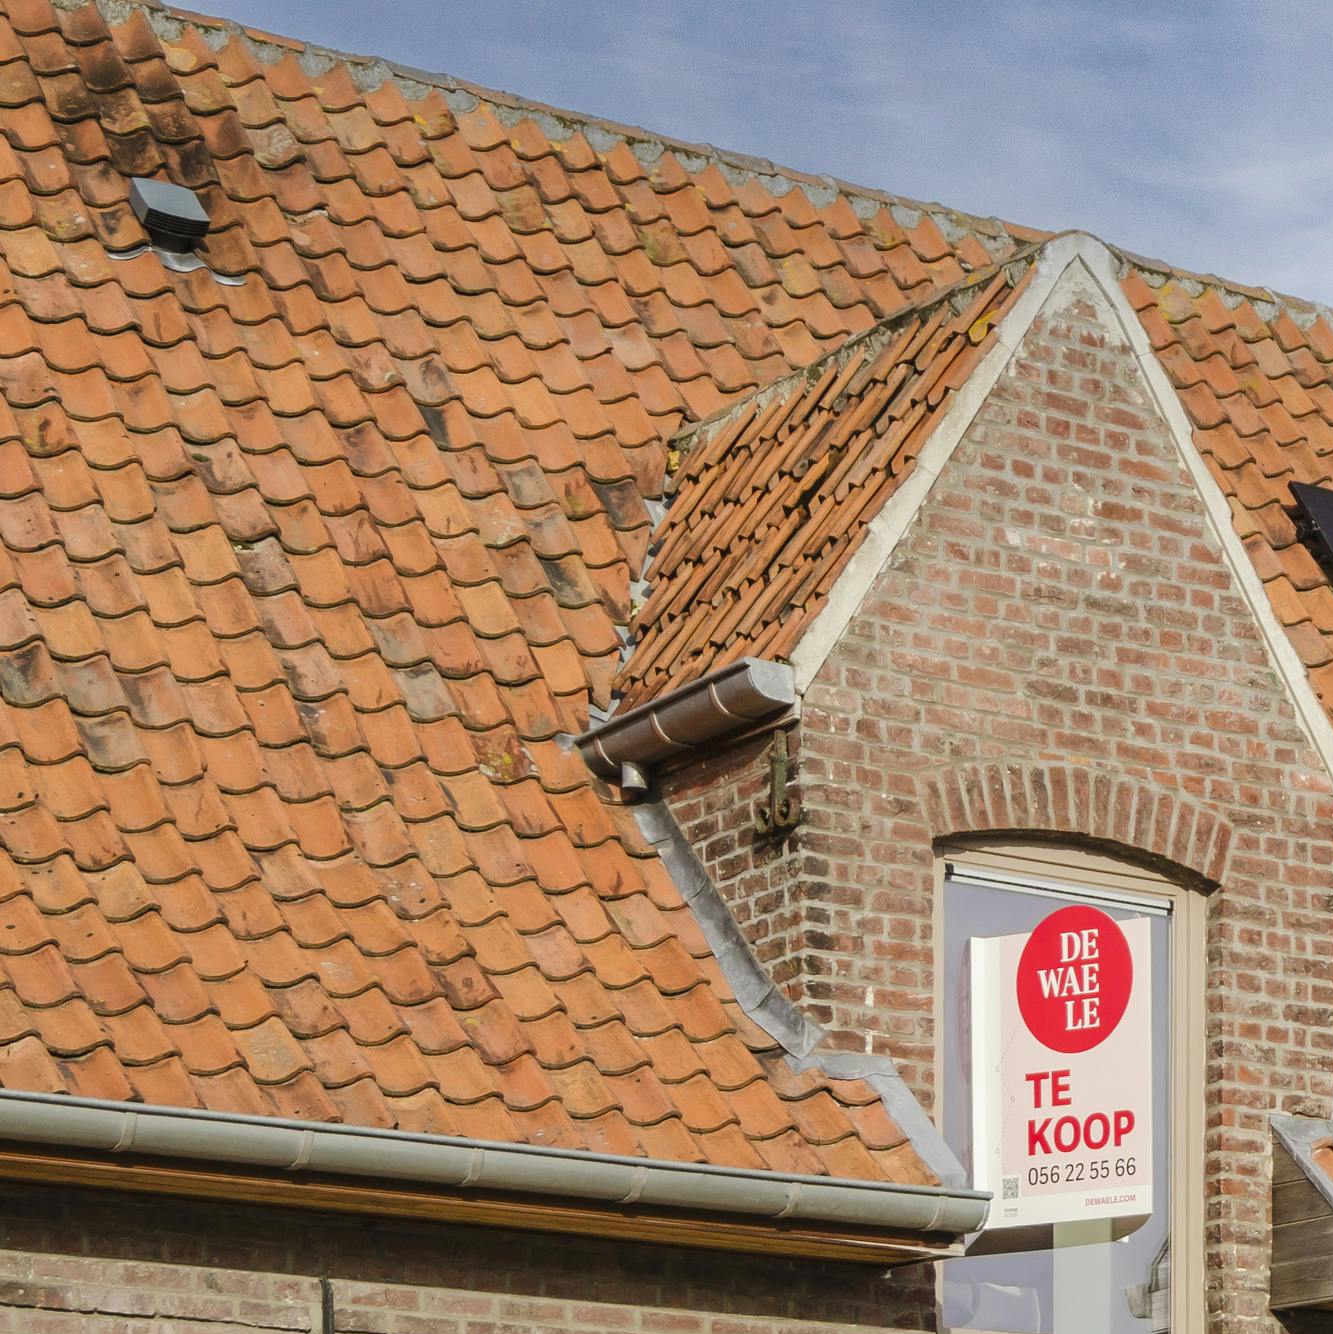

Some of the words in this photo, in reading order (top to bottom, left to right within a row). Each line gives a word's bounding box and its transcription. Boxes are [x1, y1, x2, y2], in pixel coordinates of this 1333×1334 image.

[1060, 928, 1099, 963] DE
[1036, 963, 1100, 999] WAE
[1064, 997, 1101, 1031] LE
[1025, 1069, 1072, 1109] TE
[1028, 1110, 1136, 1156] KOOP
[1028, 1165, 1060, 1186] 056
[1065, 1163, 1085, 1182] 22
[1089, 1160, 1110, 1180] 55
[1115, 1157, 1137, 1177] 66
[1085, 1194, 1136, 1206] DEWAELE.COM
